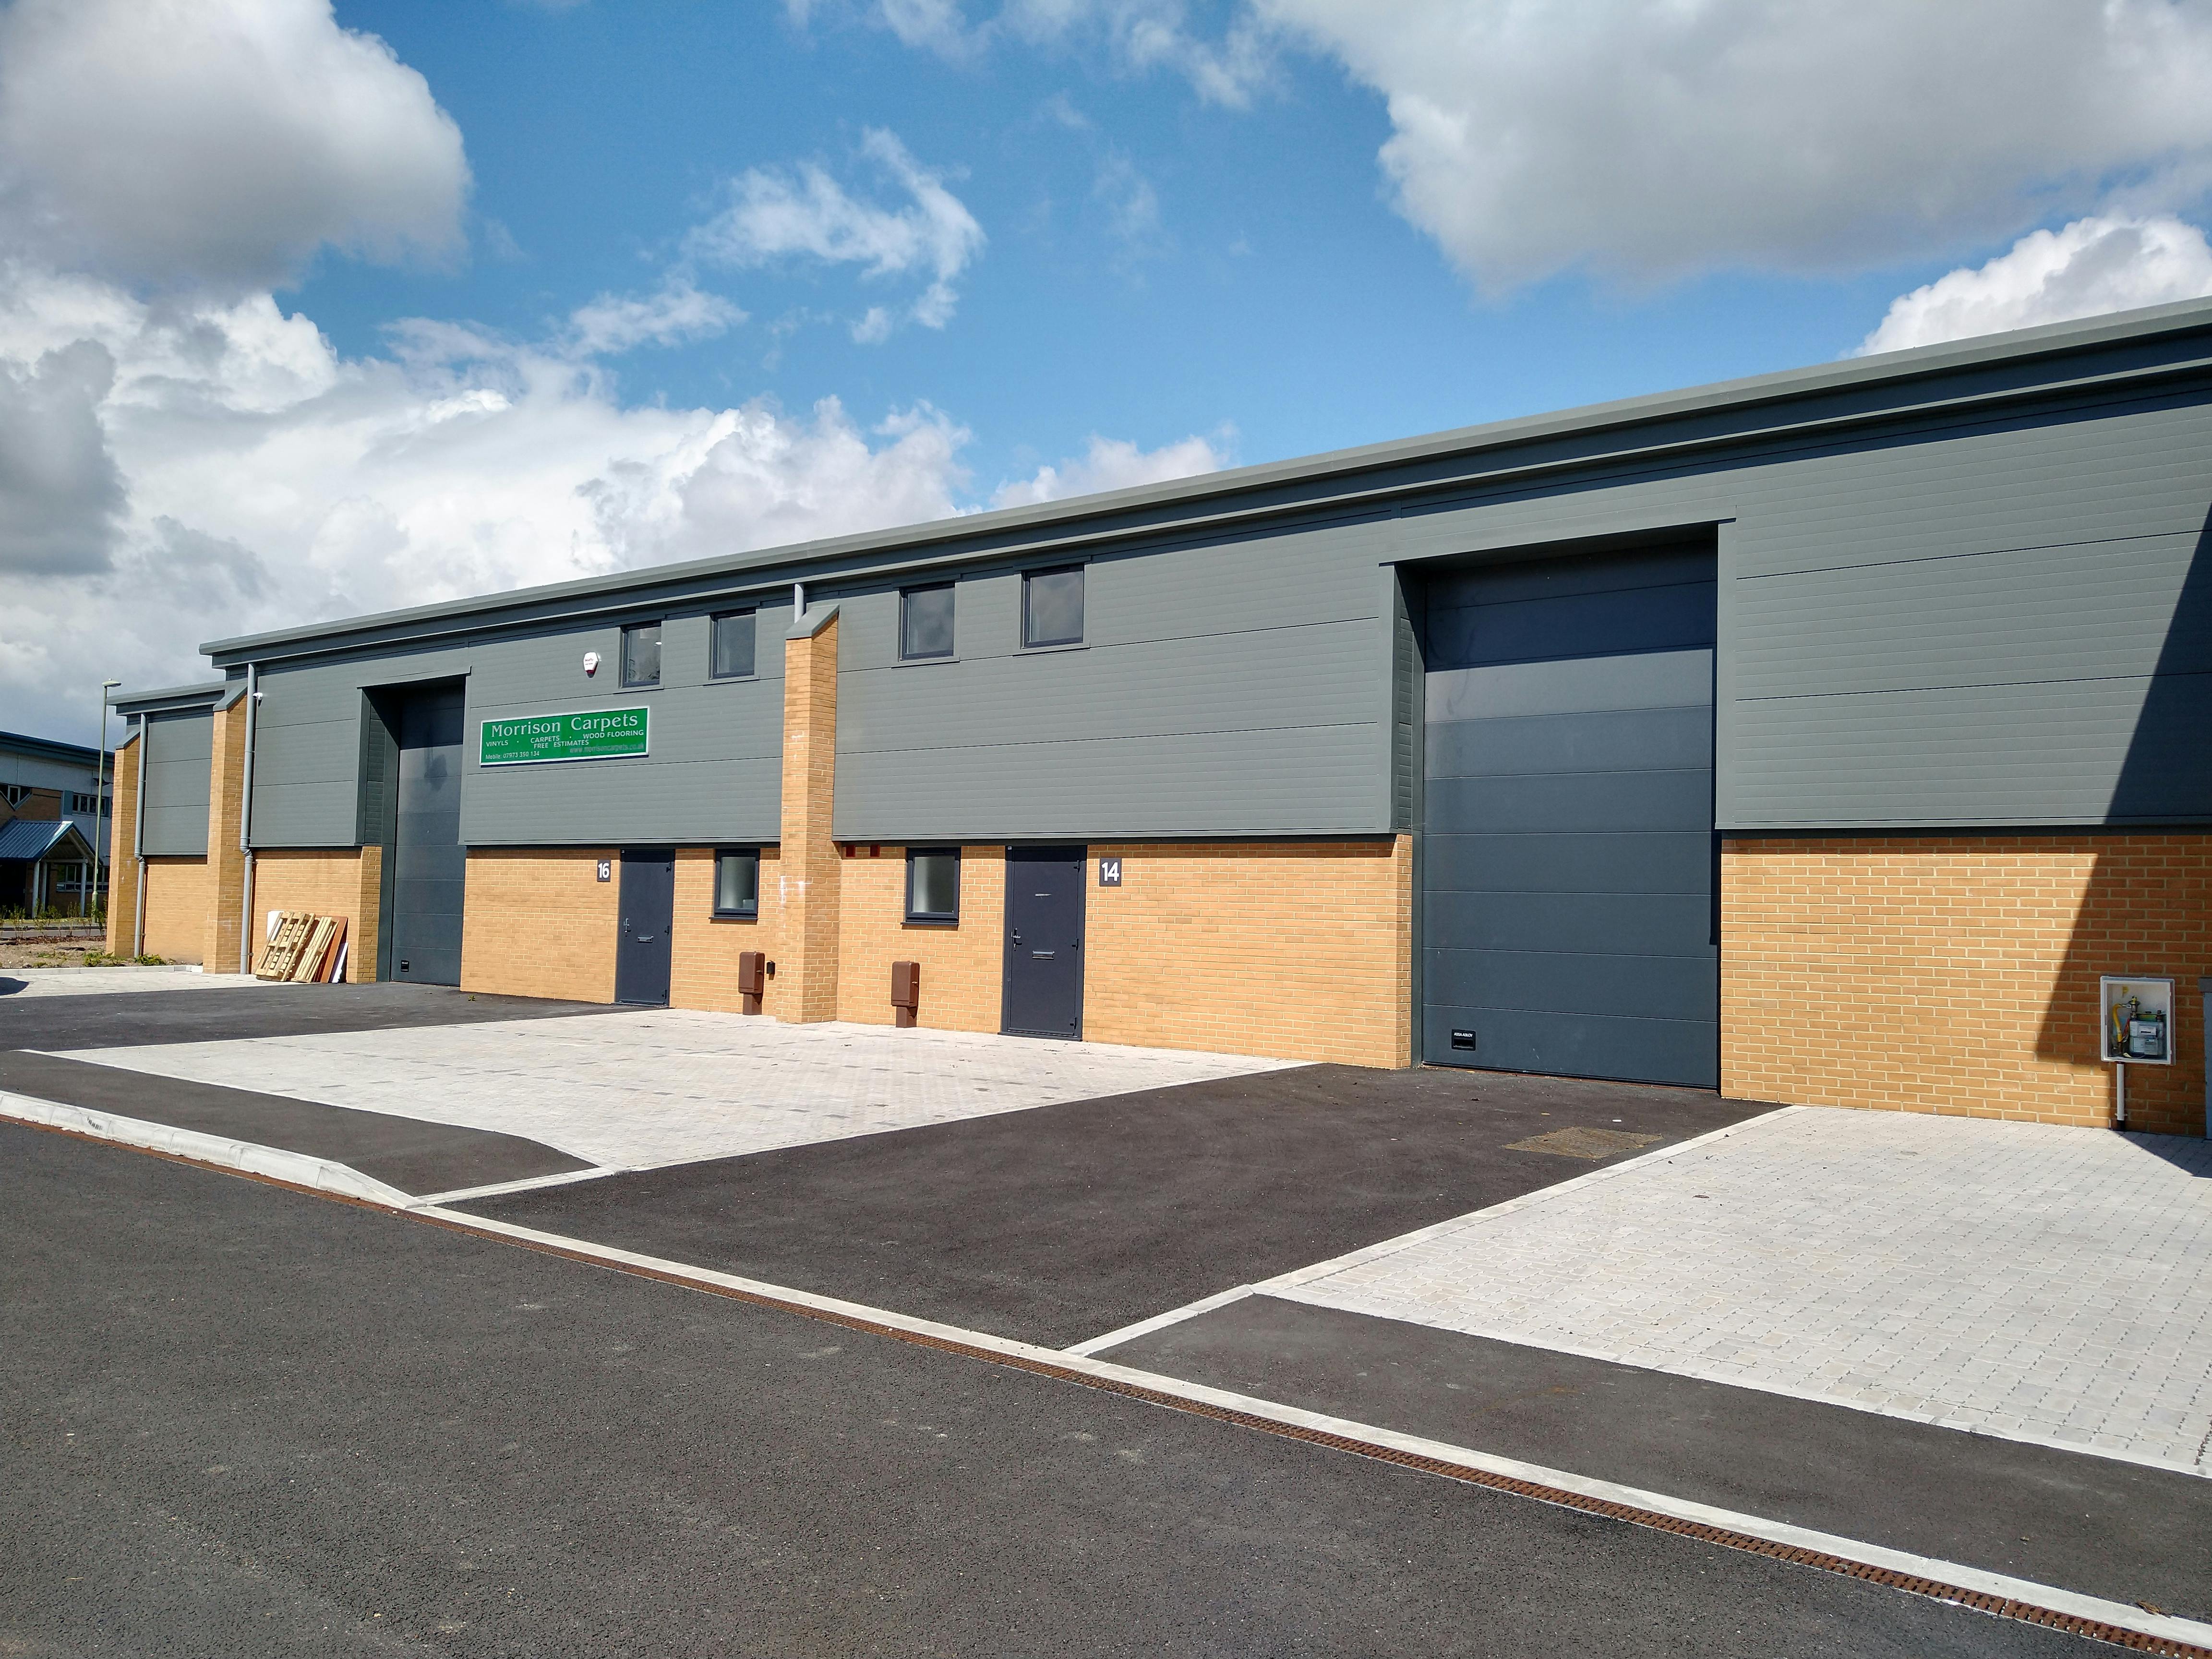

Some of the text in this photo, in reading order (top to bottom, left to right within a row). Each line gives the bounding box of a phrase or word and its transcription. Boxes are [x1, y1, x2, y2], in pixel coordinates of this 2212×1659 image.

[492, 714, 638, 737] Morrison Carpets
[530, 735, 560, 744] CARPETS
[607, 730, 644, 738] FLOORING
[553, 739, 589, 748] ESTIMATES
[598, 863, 610, 878] 16
[1101, 862, 1119, 881] 14
